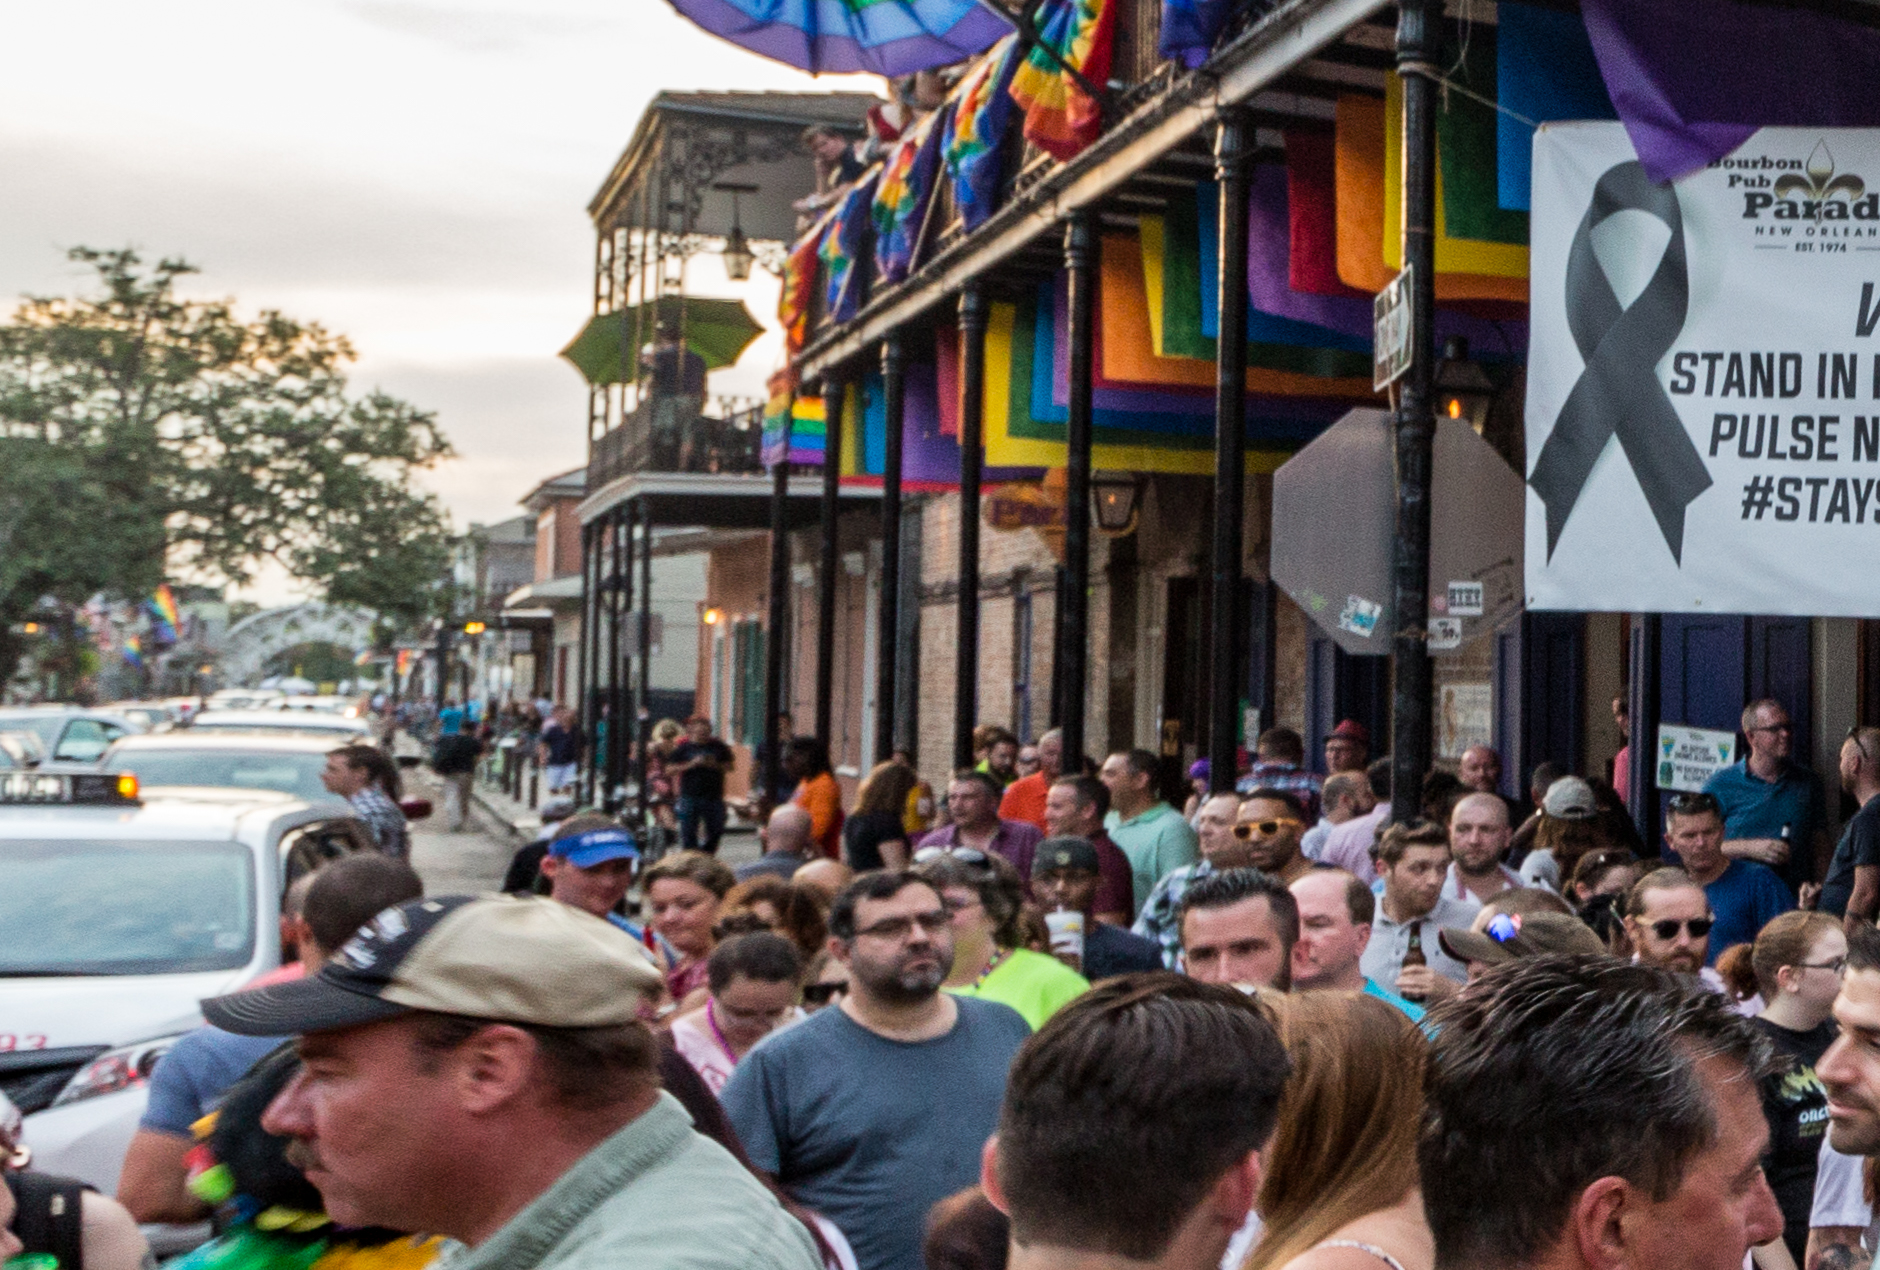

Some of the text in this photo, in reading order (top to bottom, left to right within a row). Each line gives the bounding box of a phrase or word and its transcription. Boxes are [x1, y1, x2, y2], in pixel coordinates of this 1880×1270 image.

[1707, 155, 1803, 170] Bourbon
[1728, 174, 1771, 188] Pub
[1755, 225, 1793, 235] NEW
[1795, 242, 1846, 252] EST. 1974
[1670, 351, 1802, 398] STAND
[1816, 353, 1856, 400] IN
[1708, 415, 1837, 460] PULSE
